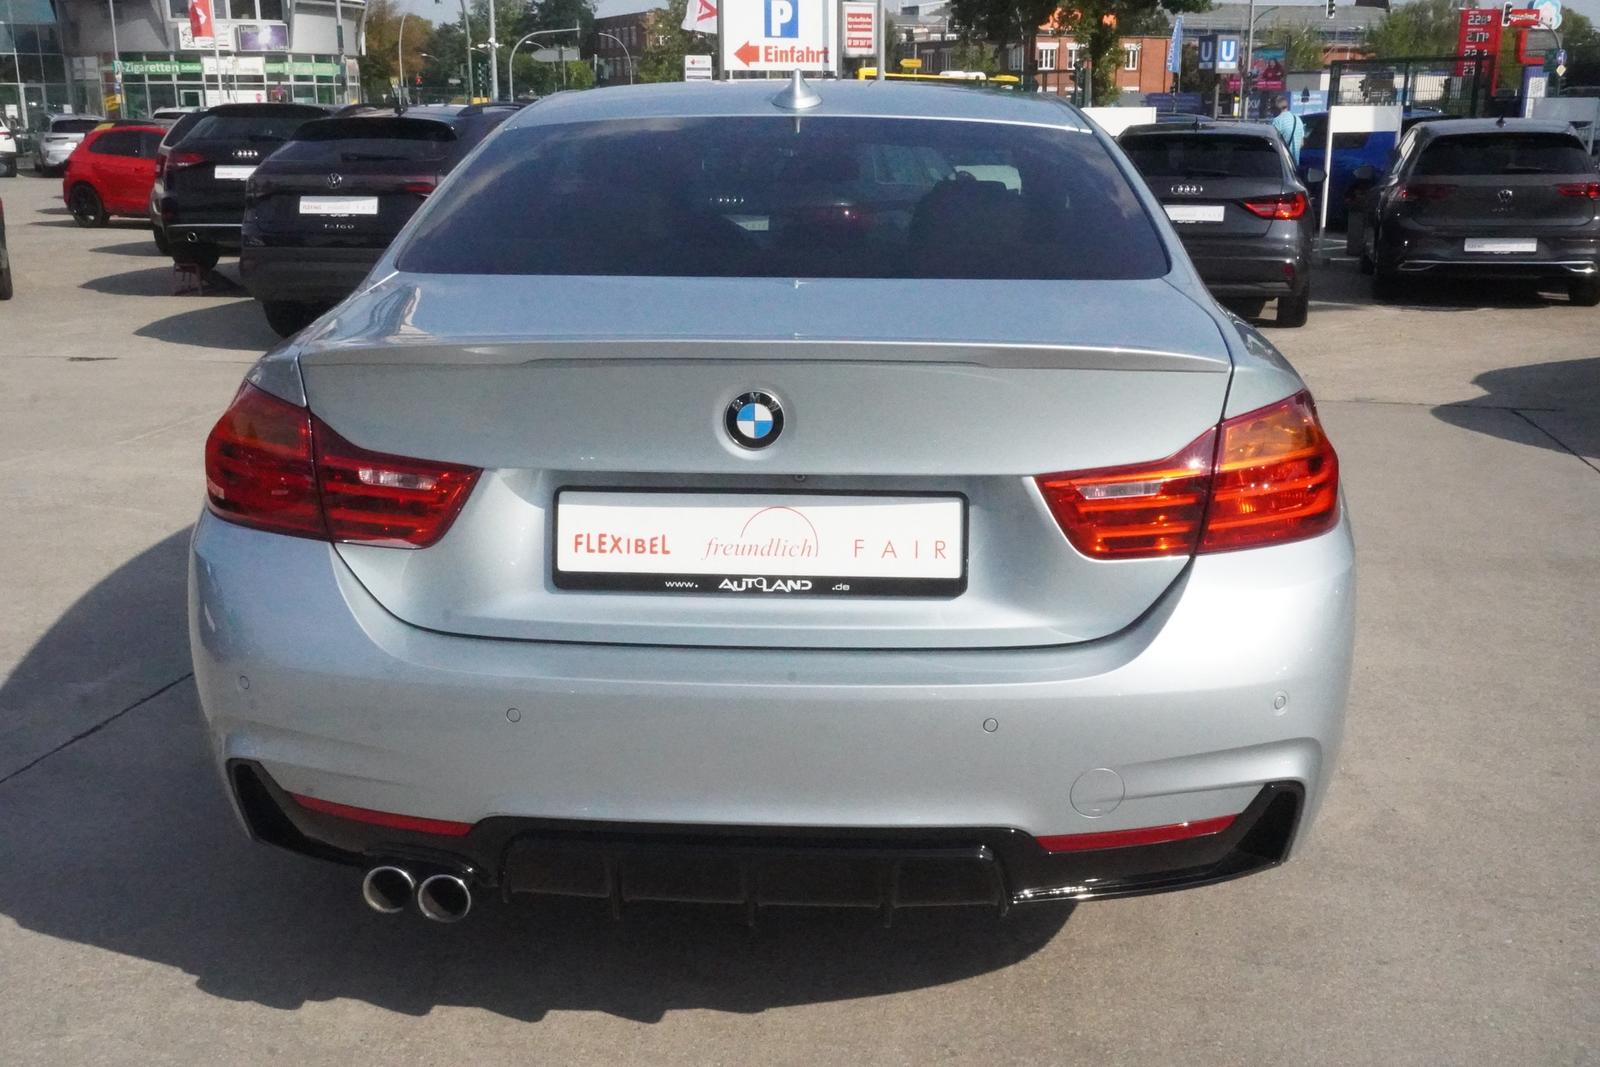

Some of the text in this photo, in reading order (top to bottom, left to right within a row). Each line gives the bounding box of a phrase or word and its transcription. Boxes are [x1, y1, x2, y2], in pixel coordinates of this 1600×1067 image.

[771, 0, 793, 36] P
[764, 45, 829, 63] Einfahrt
[1221, 41, 1235, 61] U
[574, 533, 947, 561] FLEXIBEL freundlich FAIR
[665, 577, 851, 592] www. AUTOLAND .de
